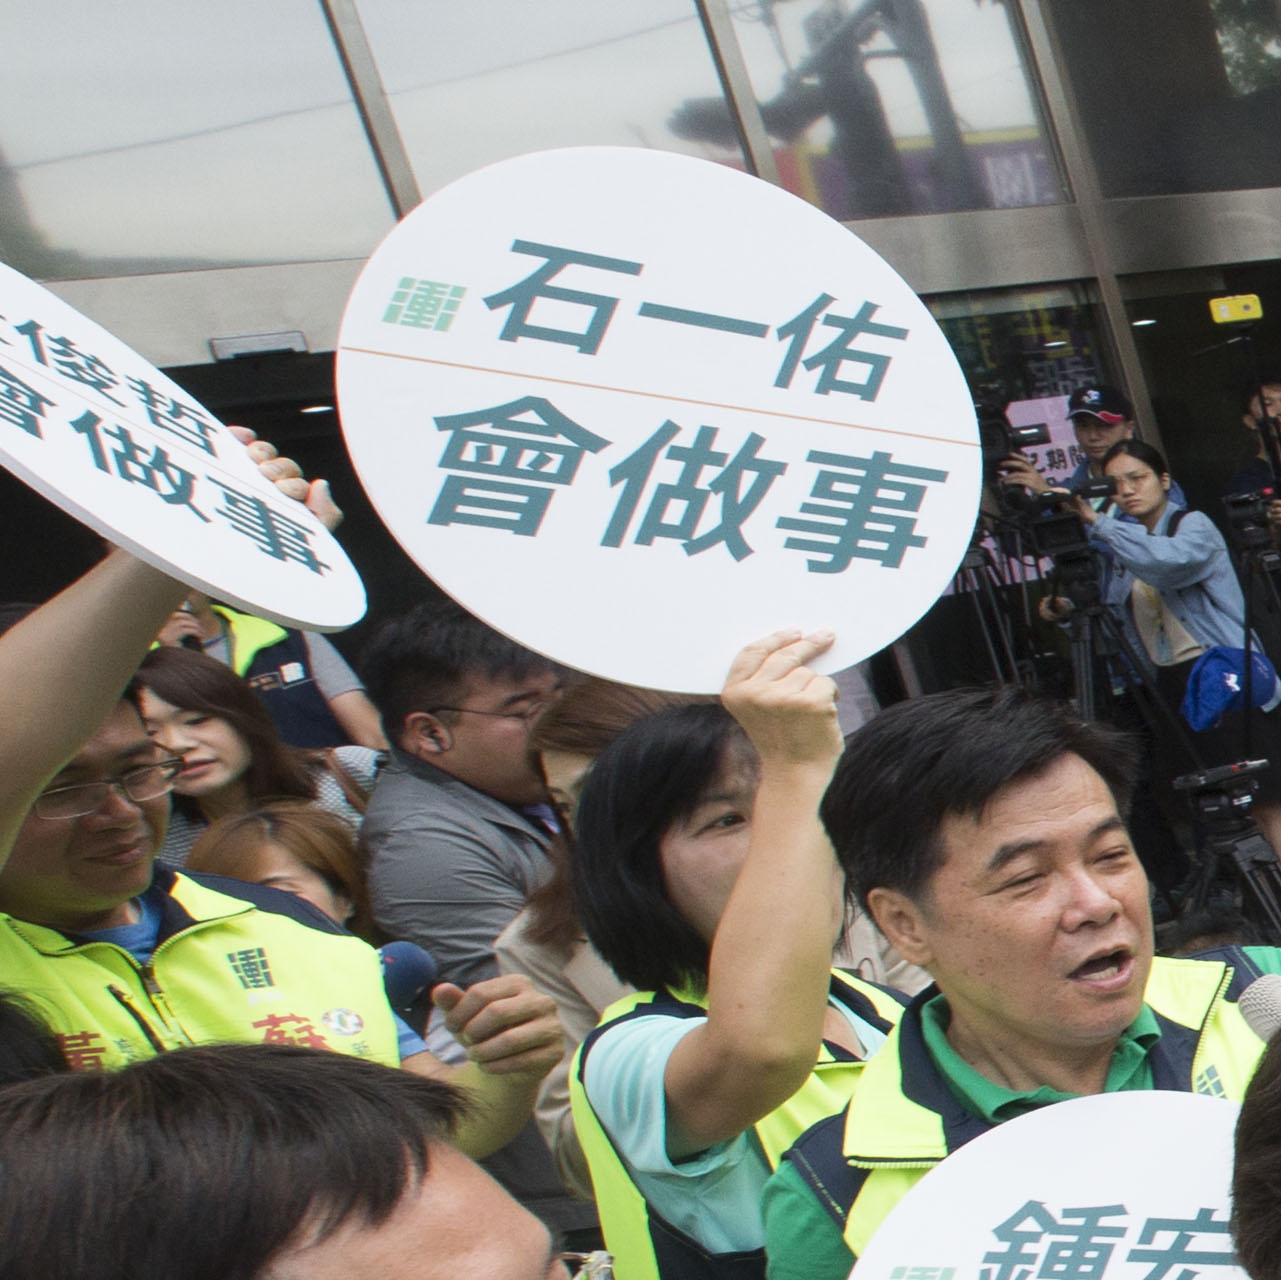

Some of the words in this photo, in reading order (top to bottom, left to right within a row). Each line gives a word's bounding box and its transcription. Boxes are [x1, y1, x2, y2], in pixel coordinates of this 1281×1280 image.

[0, 315, 220, 459] 俊哲
[482, 239, 911, 403] 石一佑
[426, 395, 949, 574] 會做事
